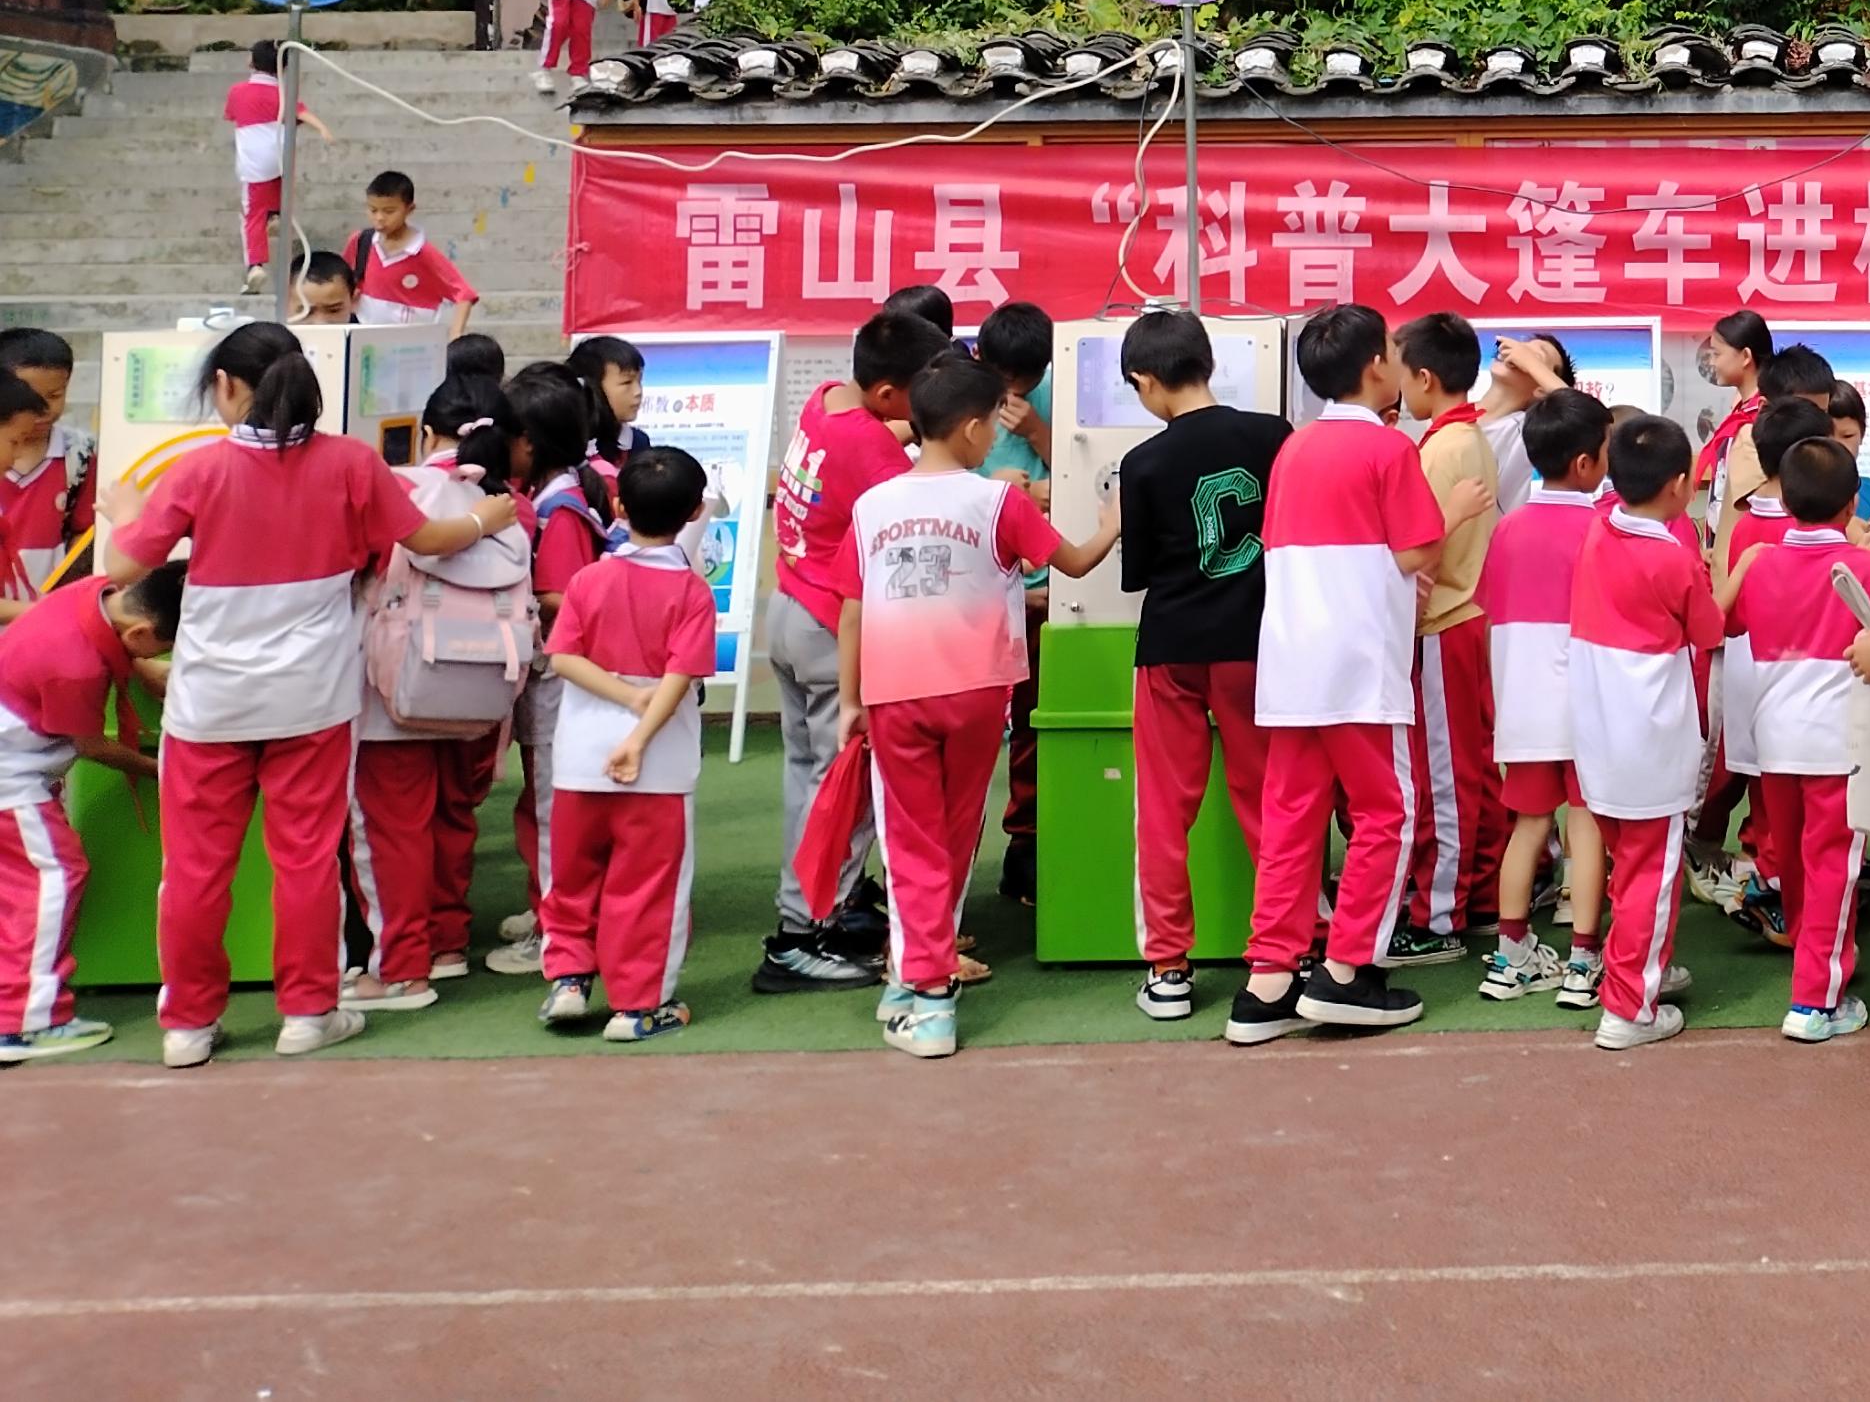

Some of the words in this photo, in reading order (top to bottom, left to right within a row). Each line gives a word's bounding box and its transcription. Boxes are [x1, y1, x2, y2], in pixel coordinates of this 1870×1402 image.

[675, 183, 1020, 310] 雷山县
[869, 518, 981, 557] SPORTMAN
[885, 545, 951, 601] 23
